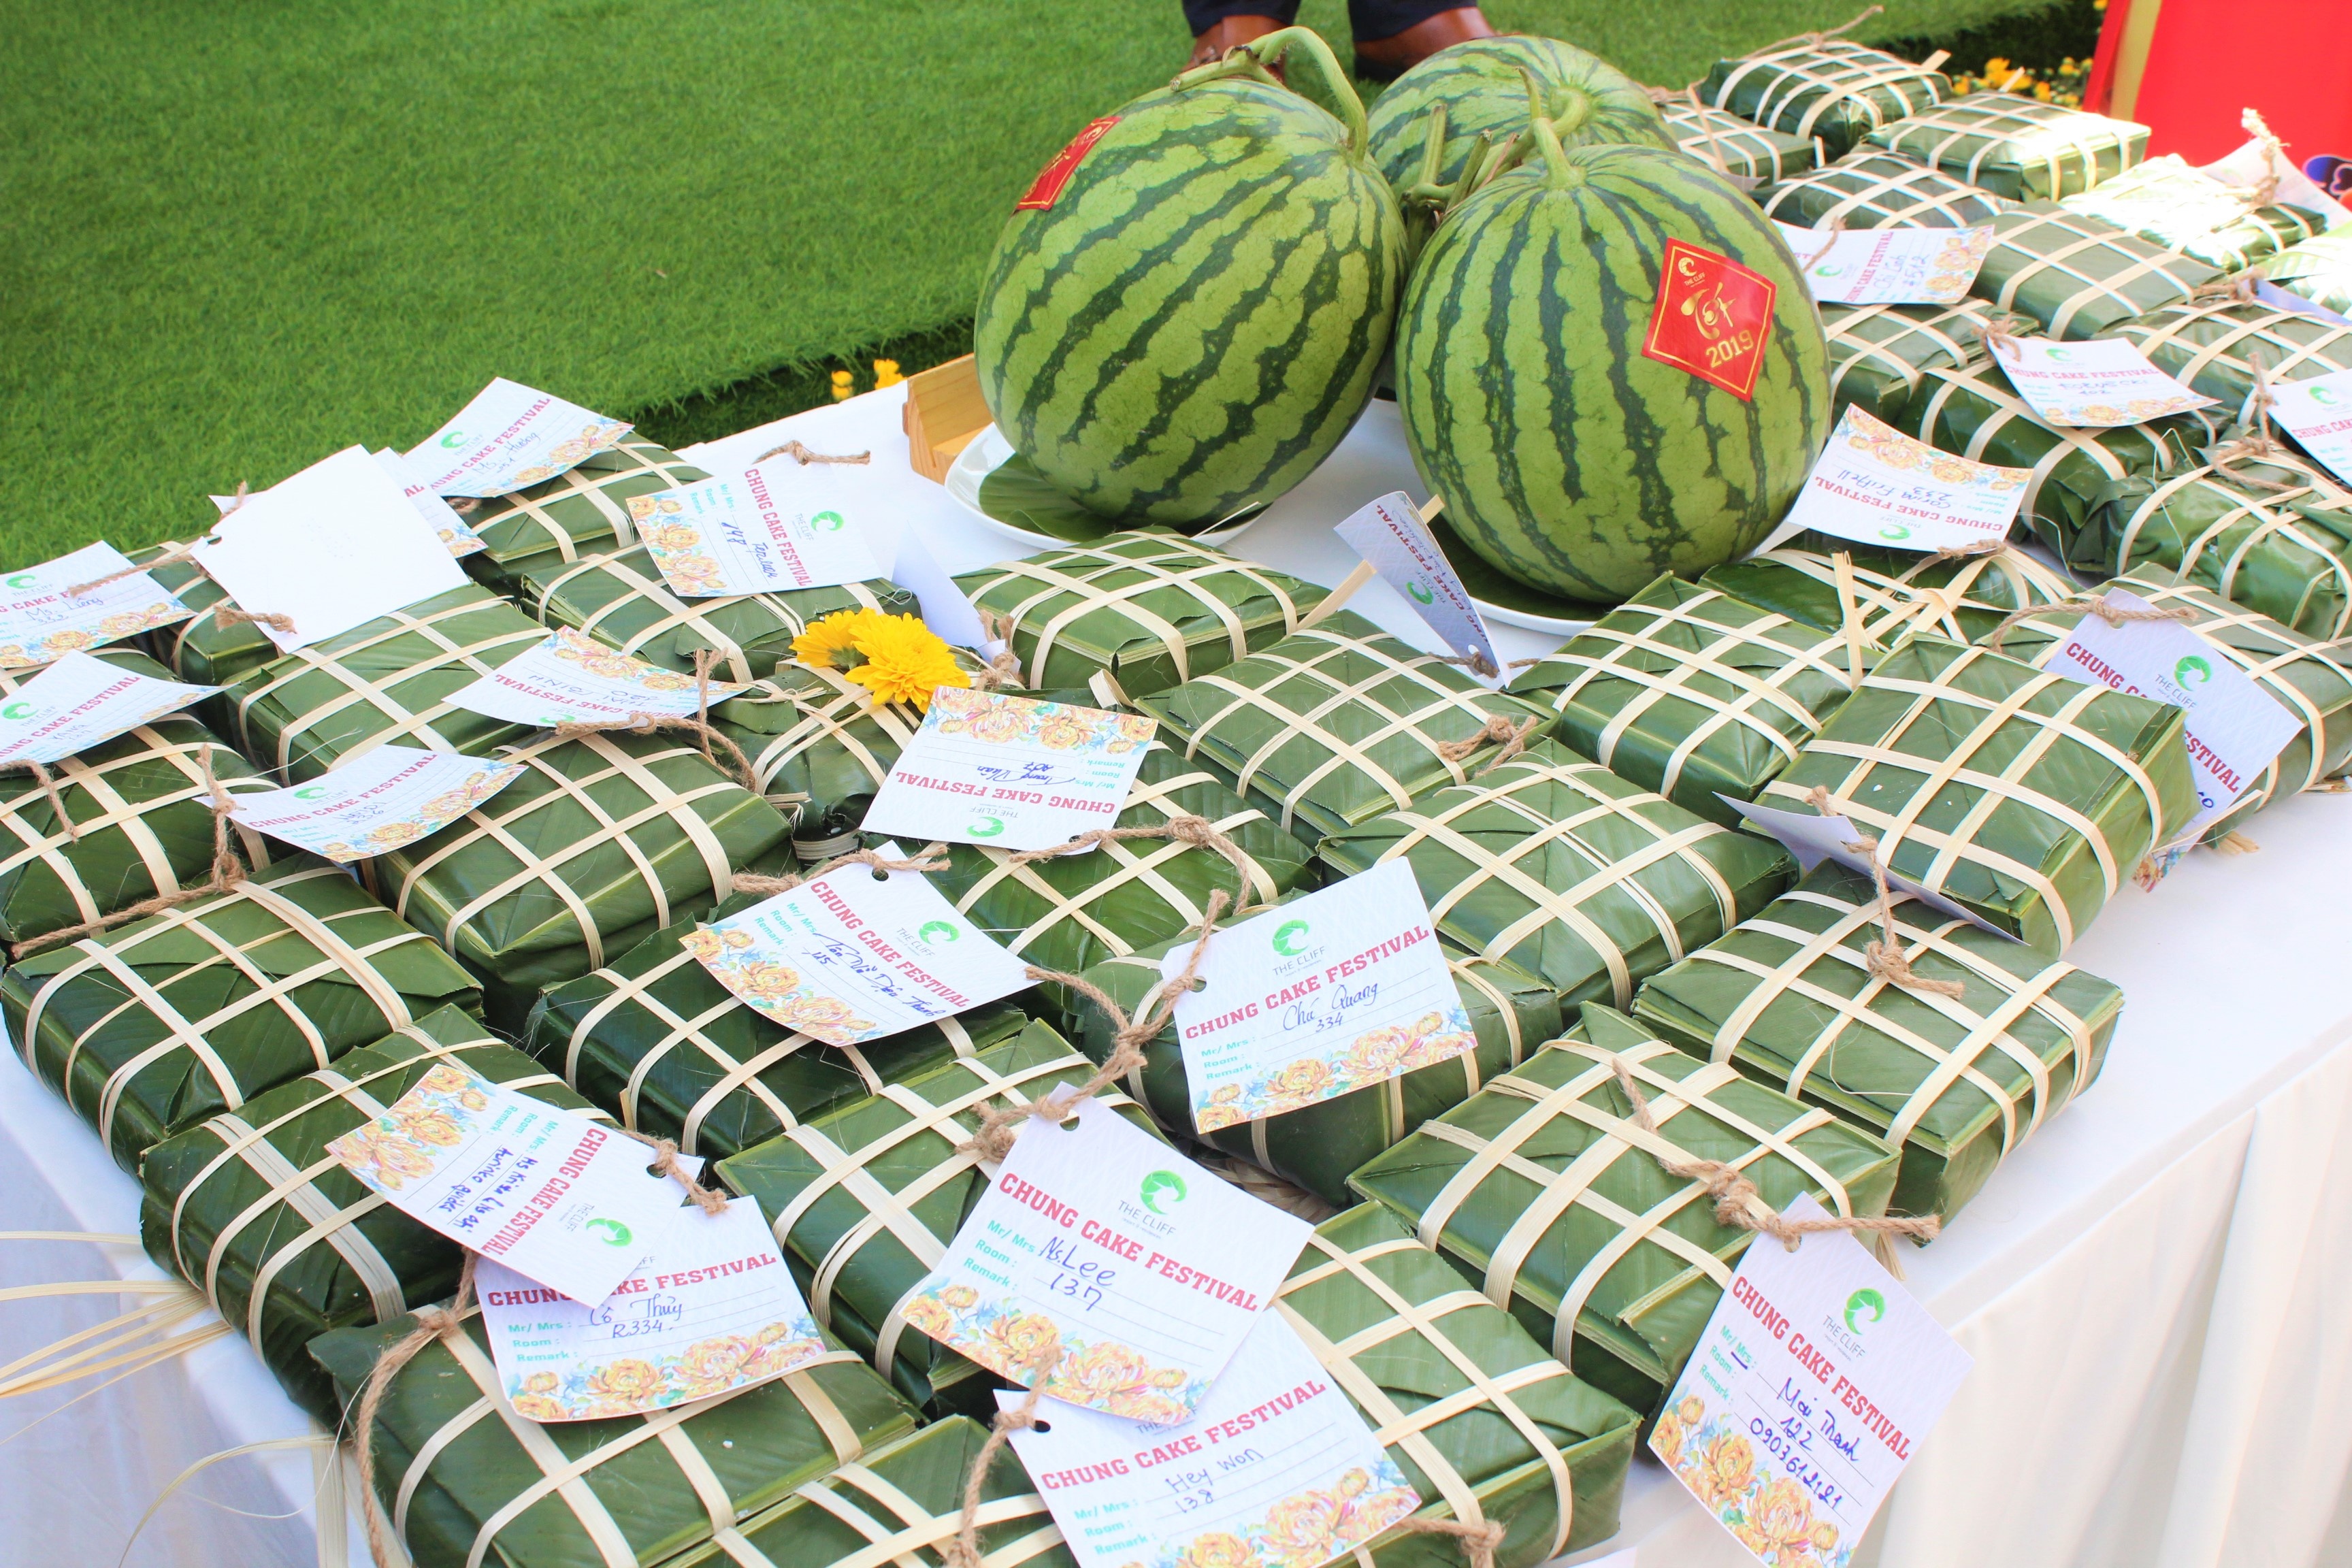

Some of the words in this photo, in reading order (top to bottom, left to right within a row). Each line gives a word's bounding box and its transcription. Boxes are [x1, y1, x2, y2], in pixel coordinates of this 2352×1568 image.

[1869, 231, 1893, 272] FESTIVAL
[1694, 272, 1705, 281] CLIFF
[1706, 330, 1754, 368] 2019
[2052, 369, 2089, 380] CAKE
[2091, 367, 2159, 378] FESTIVAL
[430, 470, 463, 489] UNG
[462, 444, 495, 468] CAKE
[494, 397, 551, 444] FESTIVAL
[1815, 476, 1893, 510] FESTIVAL
[1896, 505, 1940, 520] CAKE
[1946, 515, 2004, 532] CHUNG
[745, 469, 773, 510] CHUNG
[763, 513, 787, 540] CAKE
[777, 541, 813, 587] FESTIVAL
[1376, 505, 1433, 572] FESTIVAL
[12, 595, 58, 610] CAKE
[1433, 574, 1465, 611] CAKE
[2066, 642, 2124, 689] CHUNG
[495, 674, 576, 706] FESTIVAL
[2155, 673, 2174, 691] THE
[0, 738, 33, 757] UNG
[31, 715, 74, 738] CAKE
[69, 676, 141, 717] FESTIVAL
[577, 701, 624, 715] CAKE
[1087, 760, 1125, 768] Remark
[2185, 730, 2240, 793] STIVAL
[248, 813, 312, 829] CHUNG
[312, 799, 357, 817] CAKE
[359, 754, 438, 800] FESTIVAL
[896, 772, 988, 798] FESTIVAL
[992, 789, 1043, 804] CAKE
[1092, 781, 1115, 789] Mr/
[969, 806, 997, 817] CLIFF
[998, 809, 1019, 818] THE
[1050, 796, 1115, 814] CHUNG
[770, 909, 791, 931] Room
[787, 902, 802, 919] Mr/
[755, 917, 783, 945] Remark
[811, 881, 864, 931] CHUNG
[858, 929, 902, 964] CAKE
[896, 961, 971, 1008] FESTIVAL
[896, 927, 915, 945] THE
[911, 939, 934, 958] CLIFF
[1271, 963, 1294, 976] THE
[1296, 945, 1326, 966] CLIFF
[1185, 1002, 1258, 1040] CHUNG
[1264, 975, 1322, 1010] CAKE
[1324, 926, 1430, 984] FESTIVAL
[1331, 983, 1378, 1011] Quang
[1315, 1013, 1343, 1033] 334
[1201, 1045, 1223, 1057] Mr/
[1226, 1039, 1249, 1049] Mrs
[1203, 1056, 1239, 1068] Room
[1206, 1063, 1252, 1080] Remark
[493, 1105, 517, 1130] Remark
[516, 1113, 538, 1133] Room
[540, 1120, 558, 1139] Mr/
[531, 1135, 546, 1153] Mrs
[568, 1128, 608, 1180] CHUNG
[527, 1176, 570, 1218] CAKE
[565, 1215, 584, 1232] CLIFF
[578, 1203, 595, 1220] THE
[1117, 1200, 1141, 1220] THE
[1140, 1211, 1177, 1237] CLIFF
[480, 1209, 544, 1256] FESTIVAL
[987, 1220, 1011, 1239] Mr/
[1011, 1233, 1036, 1254] Mrs
[998, 1172, 1079, 1229] CHUNG
[1080, 1219, 1145, 1263] CAKE
[1149, 1250, 1258, 1313] FESTIVAL
[975, 1238, 1011, 1264] Room
[610, 1279, 649, 1296] KE
[655, 1253, 777, 1289] FESTIVAL
[964, 1258, 1012, 1289] Remark
[1049, 1272, 1104, 1312] 137
[508, 1323, 533, 1334] Mr/
[536, 1320, 564, 1330] Mrs
[1823, 1315, 1842, 1337] THE
[1839, 1333, 1865, 1358] CLIFF
[512, 1337, 552, 1348] Room
[1720, 1324, 1737, 1345] Mr/
[1735, 1341, 1752, 1364] Mrs
[517, 1351, 570, 1362] Remark
[1709, 1344, 1733, 1373] Room
[1731, 1276, 1791, 1341] CHUNG
[1787, 1333, 1835, 1384] CAKE
[1831, 1374, 1909, 1461] FESTIVAL
[1699, 1363, 1729, 1399] Remark
[1041, 1457, 1130, 1490] CHUNG
[1134, 1435, 1202, 1467] CAKE
[1204, 1378, 1326, 1444] FESTIVAL
[1780, 1417, 1815, 1452] 122
[1075, 1507, 1103, 1522] Mr/
[1103, 1501, 1131, 1515] Mrs
[1176, 1490, 1215, 1514] 138
[1085, 1520, 1125, 1537] Room
[1094, 1535, 1149, 1554] Remark
